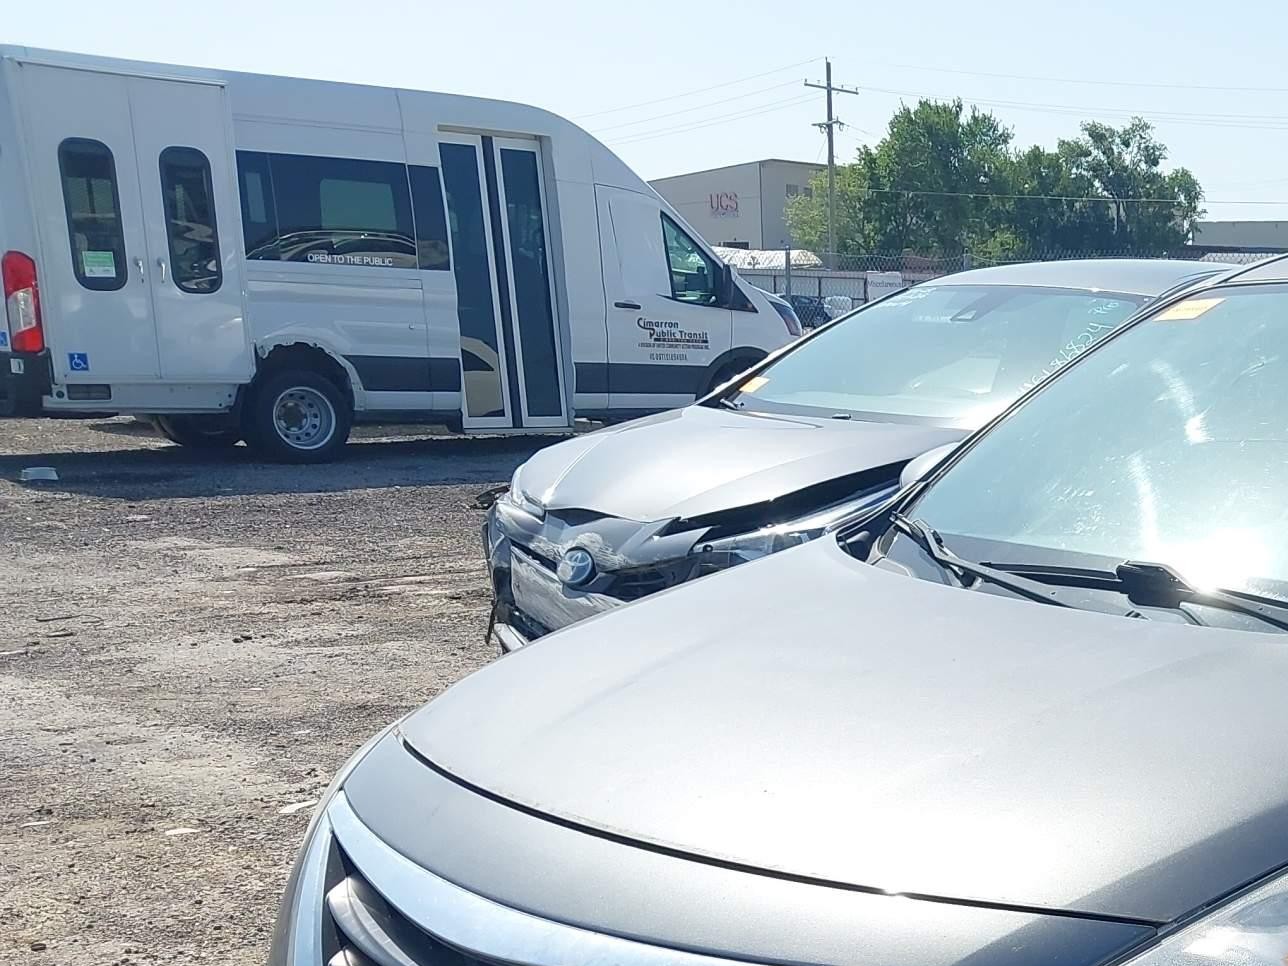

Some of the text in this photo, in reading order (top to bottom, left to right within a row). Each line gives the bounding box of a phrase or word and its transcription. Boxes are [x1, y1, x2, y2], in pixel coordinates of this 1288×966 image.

[710, 192, 738, 211] UCS
[307, 253, 393, 266] OPEN TO THE PUBLIC
[637, 317, 679, 329] Cimarron
[649, 328, 708, 339] Public Transit
